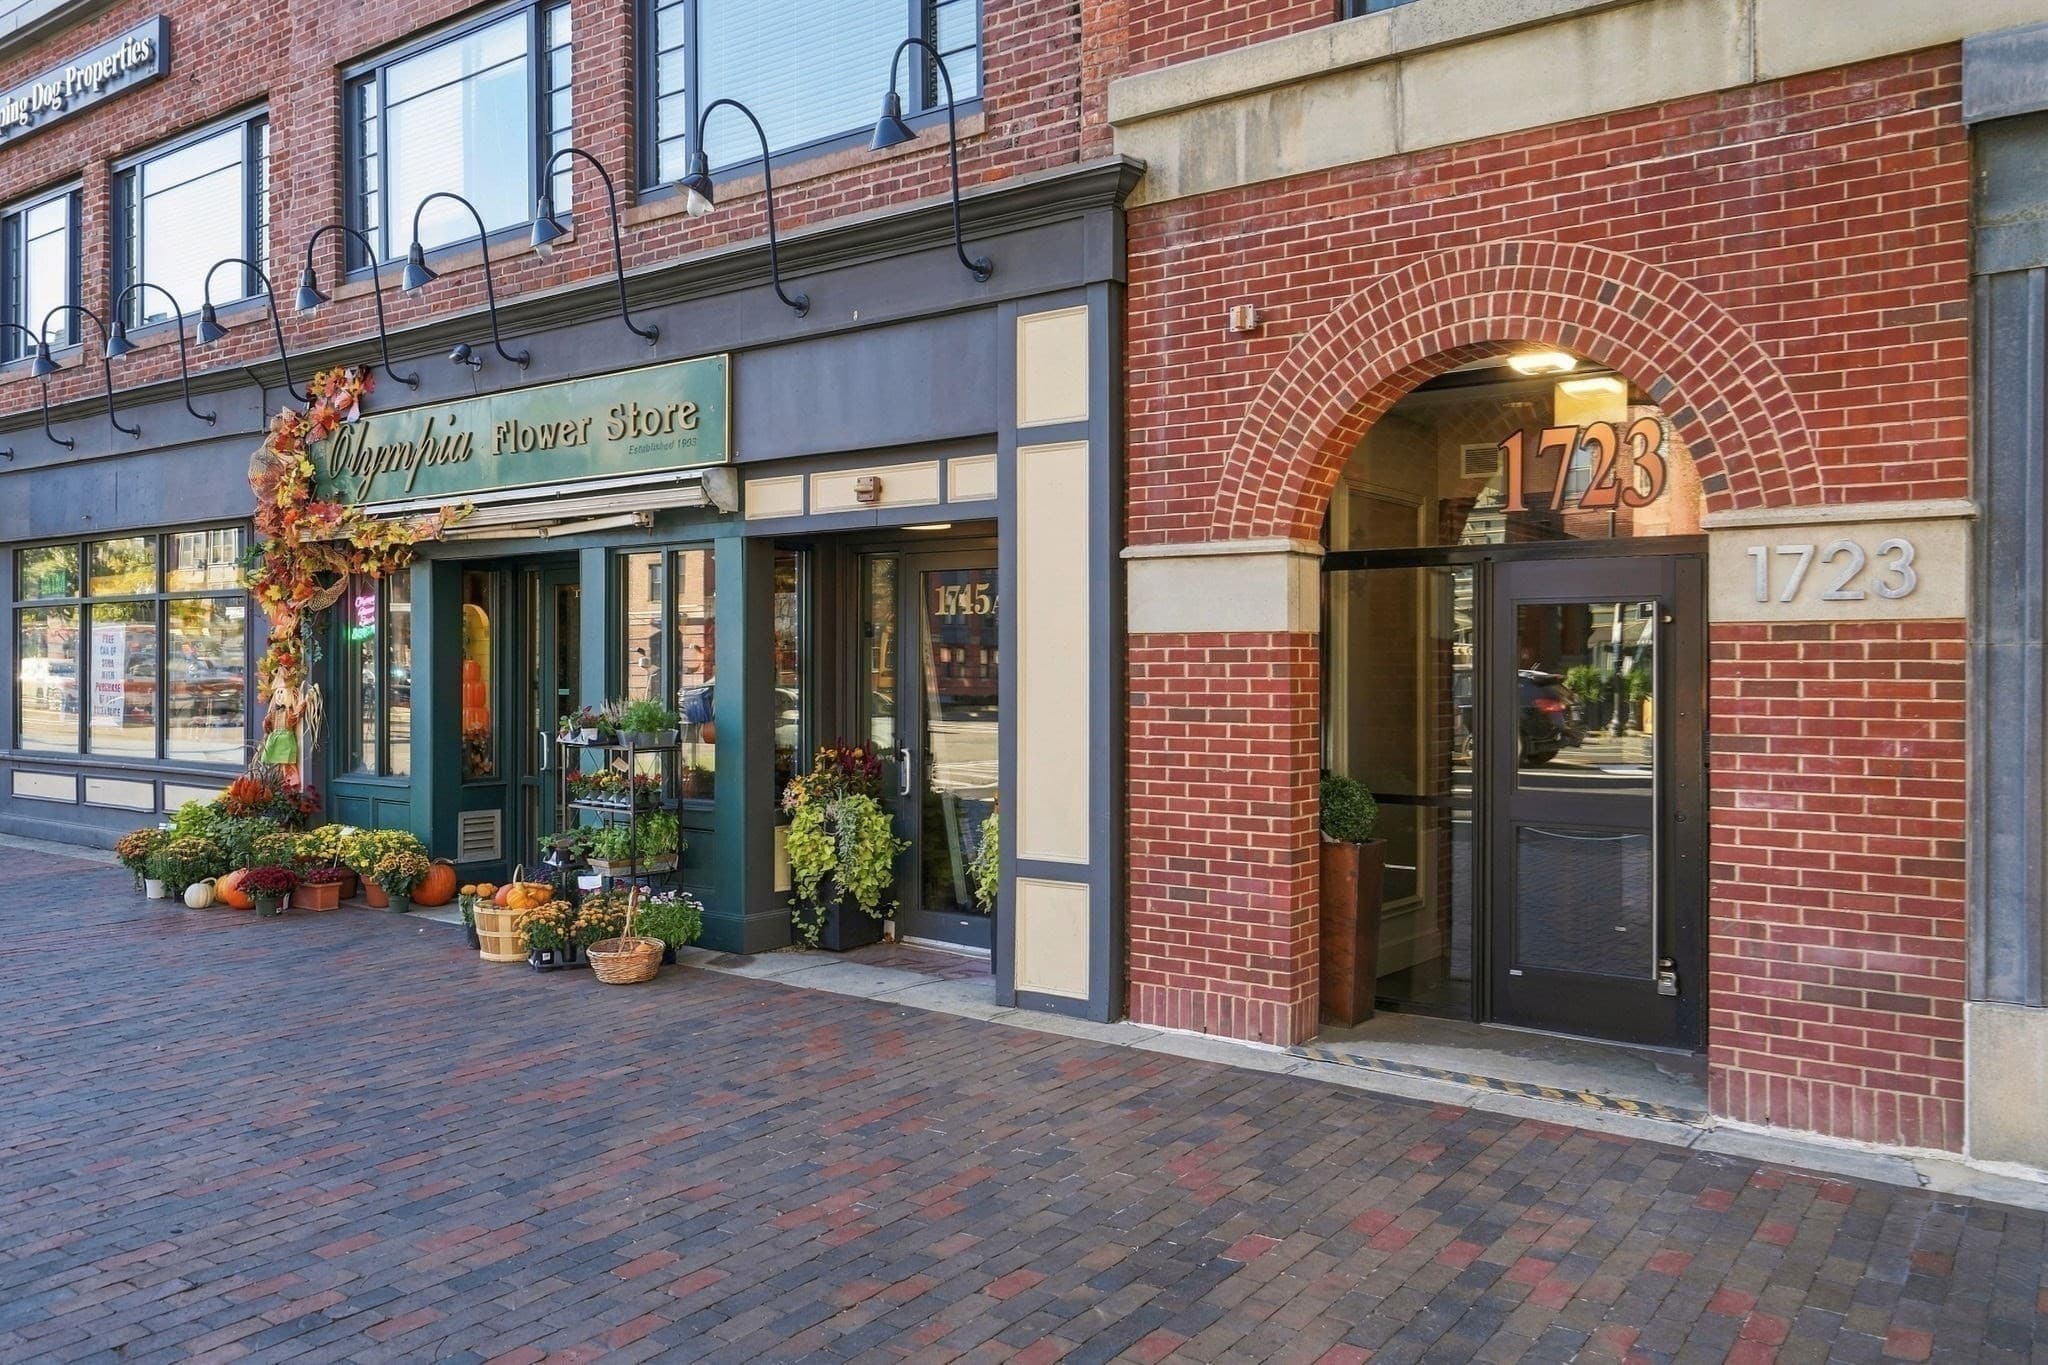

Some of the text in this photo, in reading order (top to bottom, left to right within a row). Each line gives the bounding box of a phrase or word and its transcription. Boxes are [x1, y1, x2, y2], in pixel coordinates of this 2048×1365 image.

[32, 79, 62, 111] Dog
[65, 36, 150, 97] Properties
[328, 400, 699, 501] Olympia Flower Store
[628, 439, 675, 455] Established
[1498, 416, 1667, 513] 1723
[1747, 537, 1918, 602] 1723
[95, 682, 120, 693] PURCHASE
